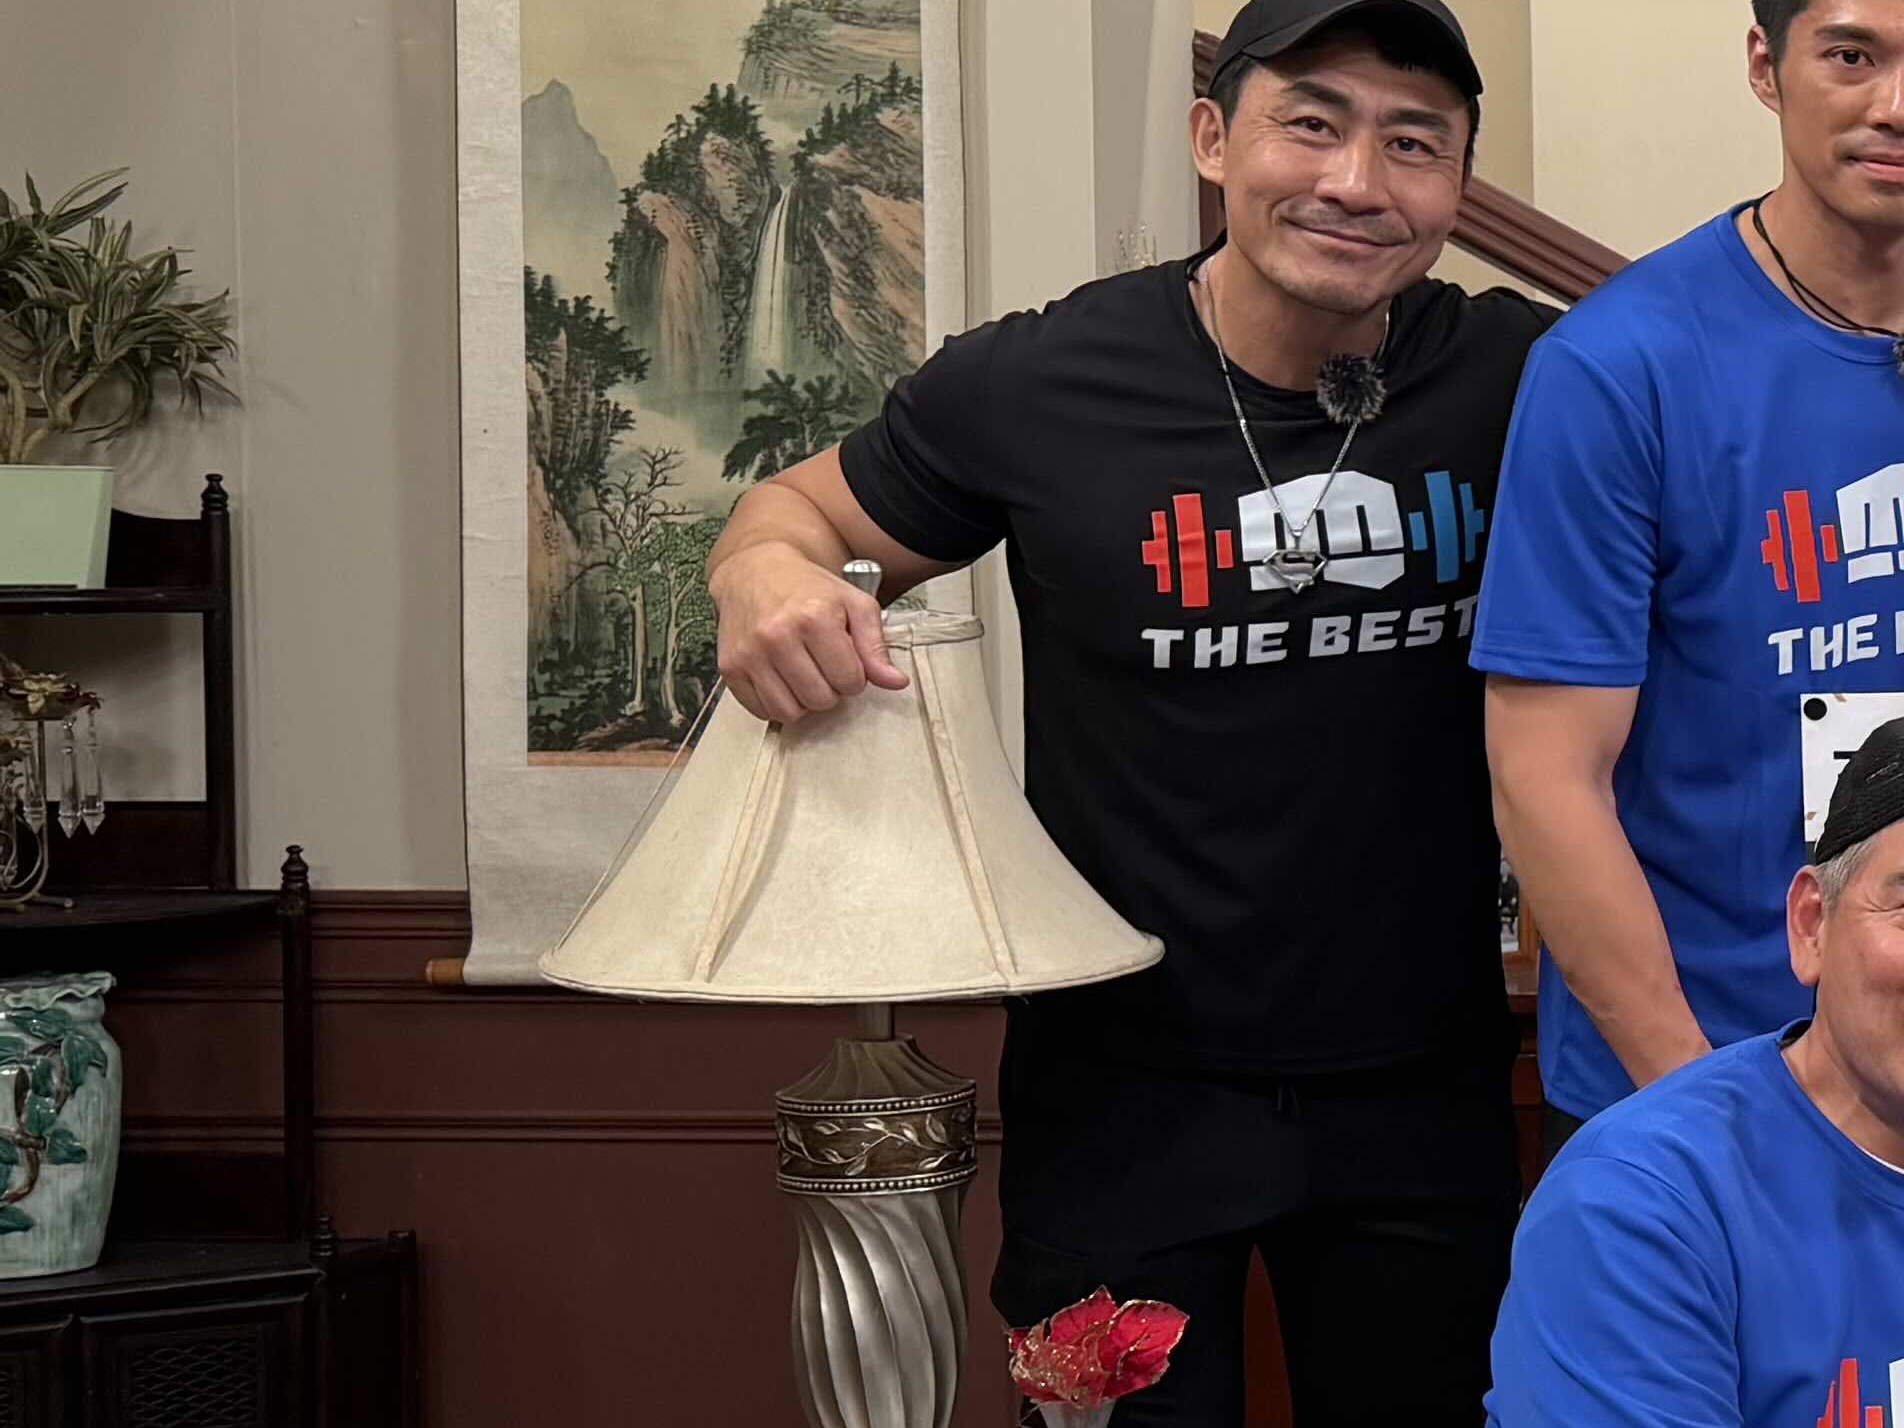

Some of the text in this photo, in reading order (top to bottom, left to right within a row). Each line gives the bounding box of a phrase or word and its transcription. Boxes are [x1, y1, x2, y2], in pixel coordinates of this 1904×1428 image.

[1141, 594, 1479, 668] THE BEST
[1768, 613, 1880, 676] THE
